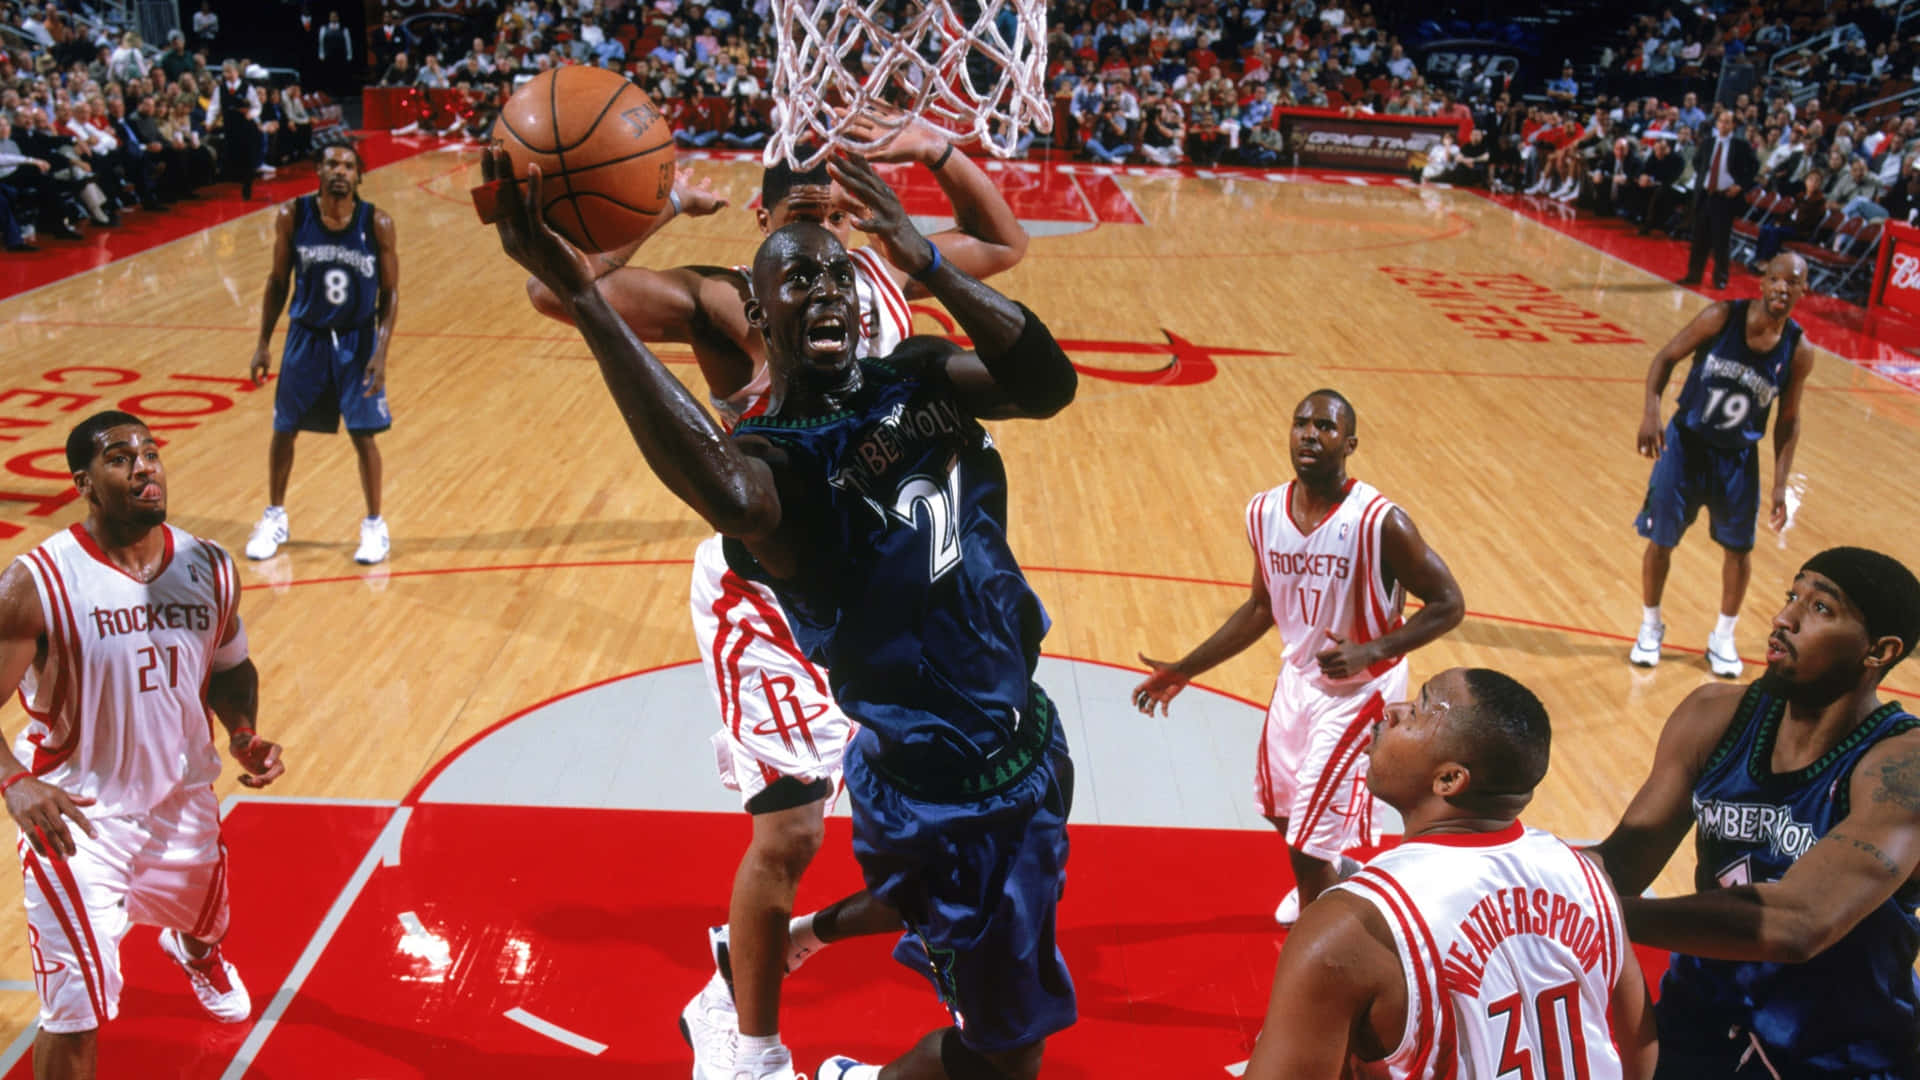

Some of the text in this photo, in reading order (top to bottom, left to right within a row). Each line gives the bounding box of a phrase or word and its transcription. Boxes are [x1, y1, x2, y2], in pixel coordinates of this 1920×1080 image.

[325, 270, 349, 305] 8
[1378, 266, 1551, 343] CENTER
[1456, 272, 1647, 344] TOYOTA
[1701, 387, 1750, 429] 19
[1269, 549, 1350, 579] ROCKETS
[89, 602, 210, 641] ROCKETS
[1298, 586, 1321, 626] 17
[137, 646, 178, 692] 21
[1442, 886, 1602, 999] WEATHERSPOON
[1487, 980, 1592, 1080] 30
